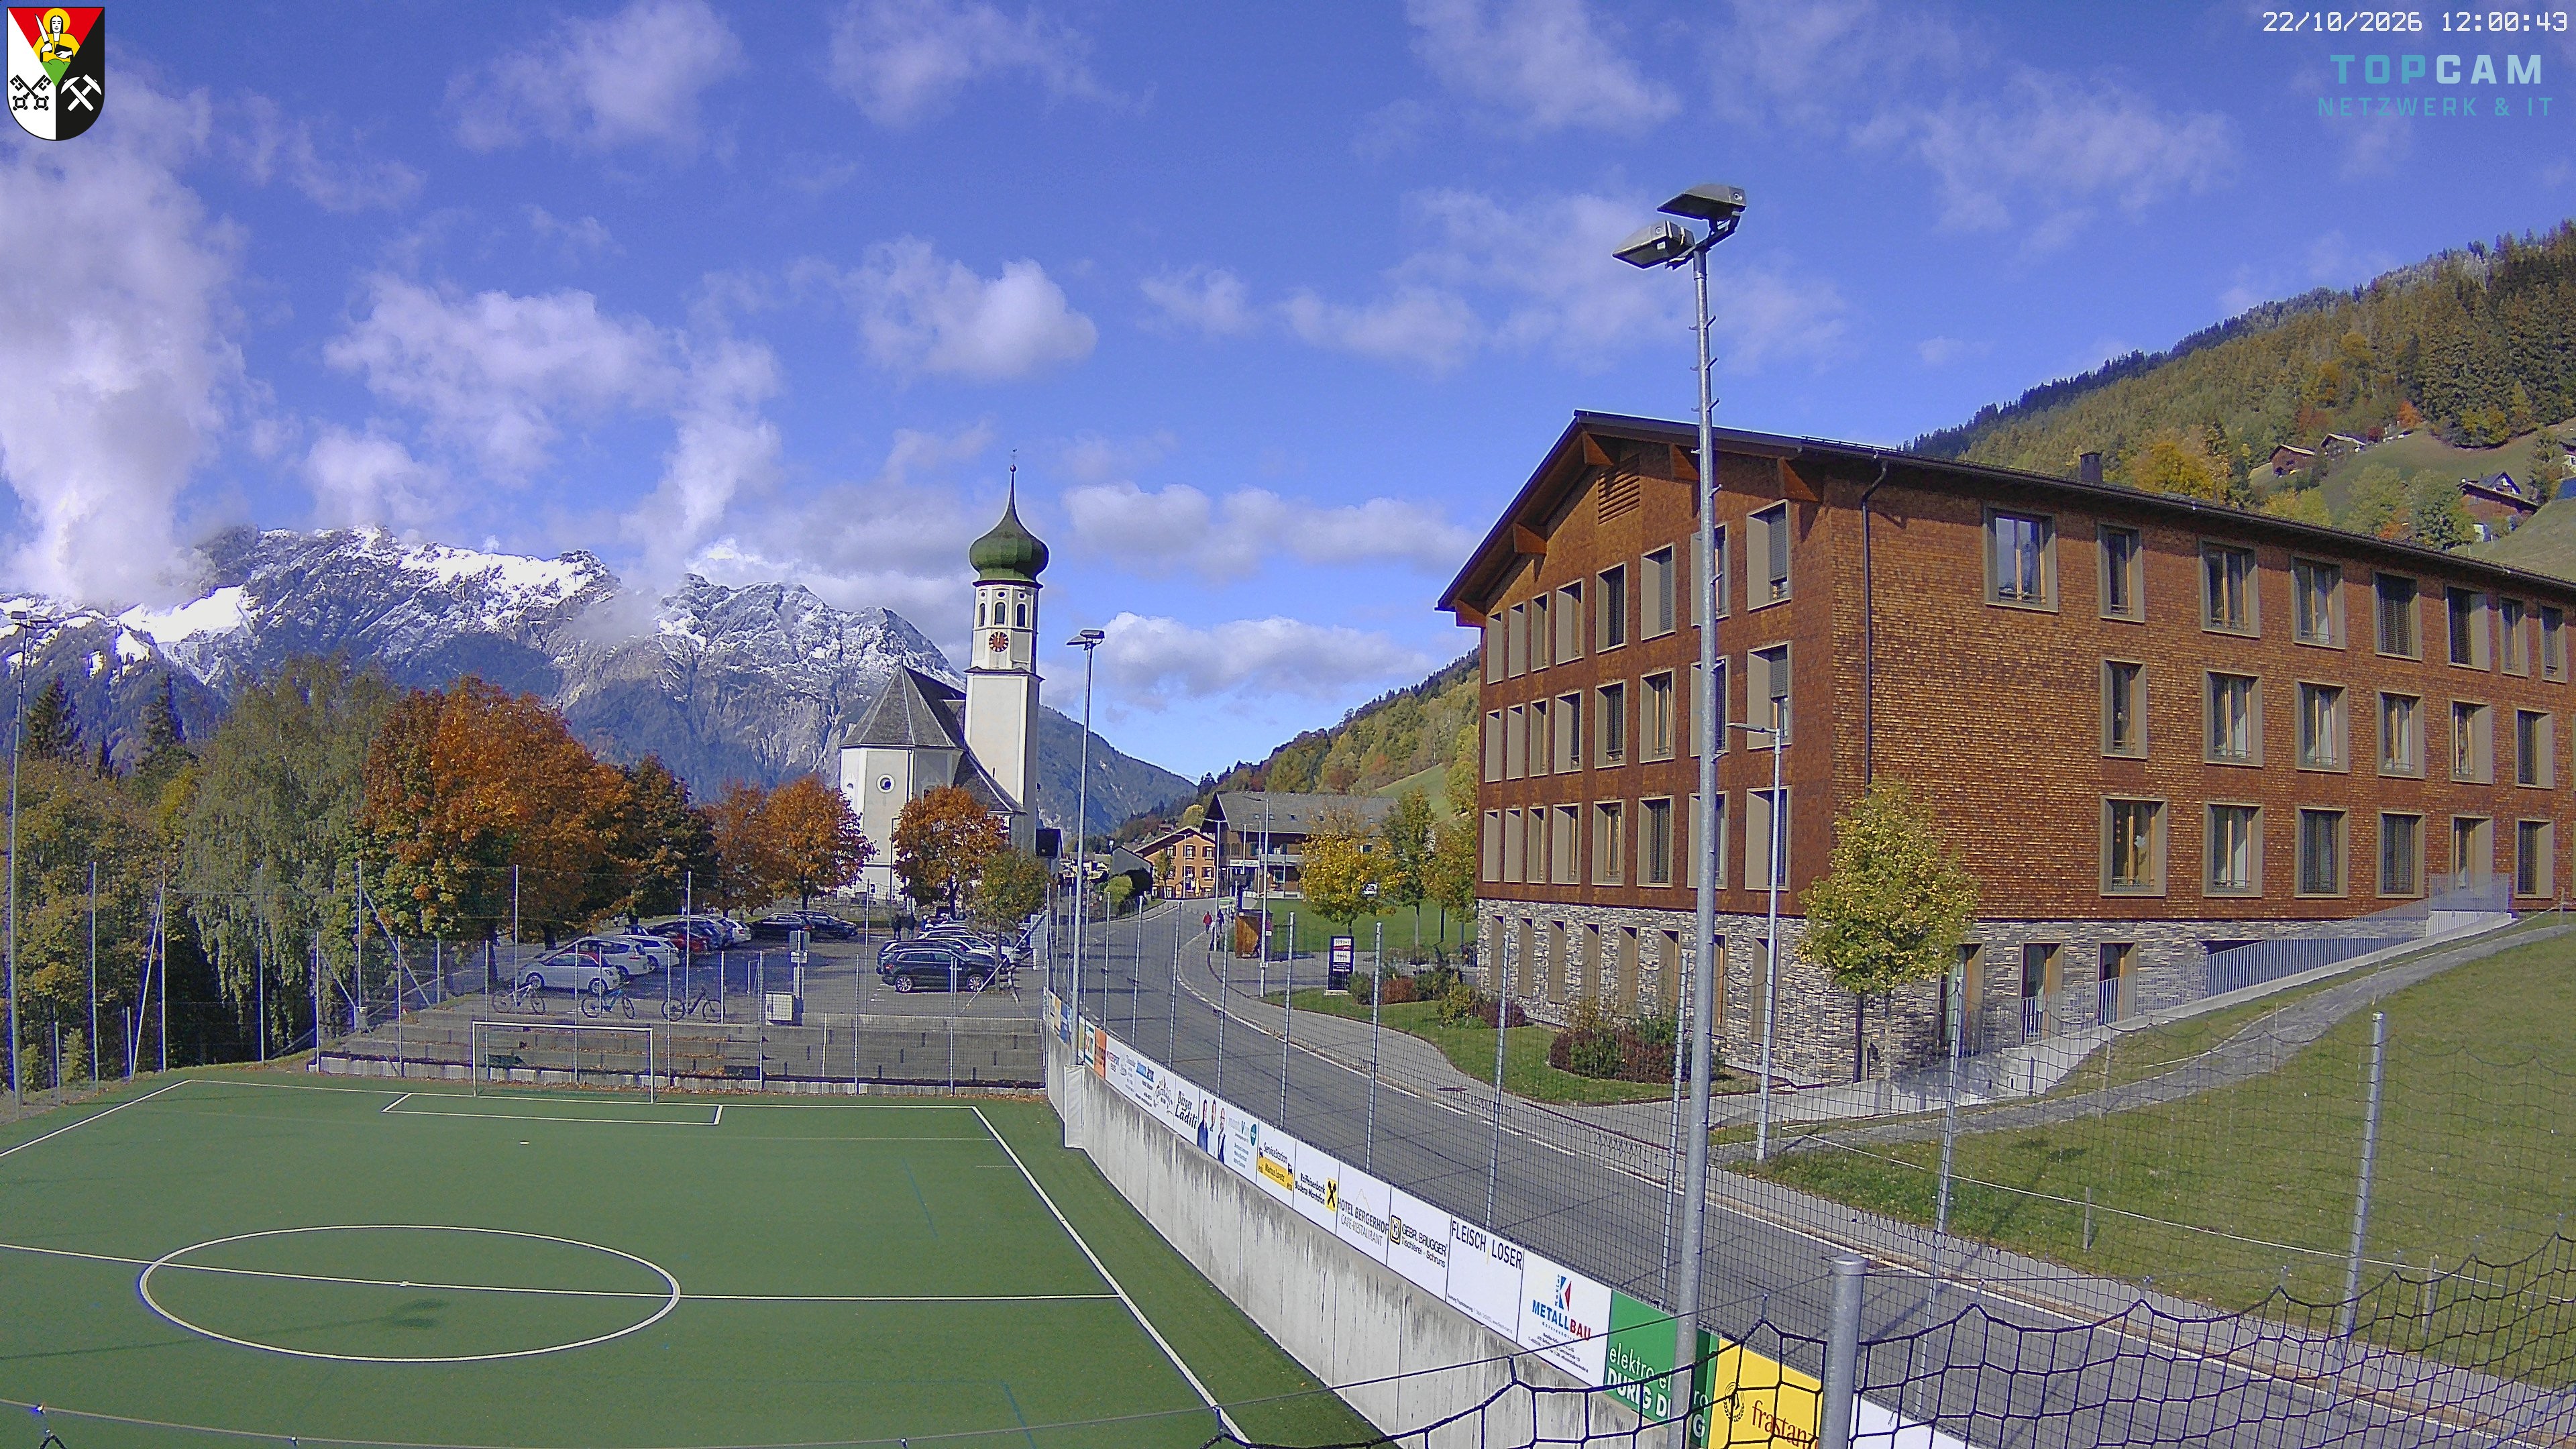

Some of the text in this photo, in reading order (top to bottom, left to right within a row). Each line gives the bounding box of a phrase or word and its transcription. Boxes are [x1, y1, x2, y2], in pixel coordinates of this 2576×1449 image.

[1263, 1142, 1288, 1165] ServiceStation
[1295, 1180, 1326, 1205] Bludenz-Montafon
[1300, 1173, 1326, 1195] Raiffeisenbank
[1336, 1197, 1354, 1216] HOTEL
[1354, 1205, 1390, 1235] BERGERHOF
[1401, 1224, 1418, 1242] GEBR.
[1418, 1232, 1447, 1257] BRUGGER
[1401, 1236, 1446, 1269] Tischlerei Schruns
[1451, 1220, 1523, 1271] FLEISCH LOSER
[1532, 1299, 1591, 1340] METALLBAU
[1609, 1342, 1655, 1380] elektro
[1752, 1399, 1819, 1449] frastan
